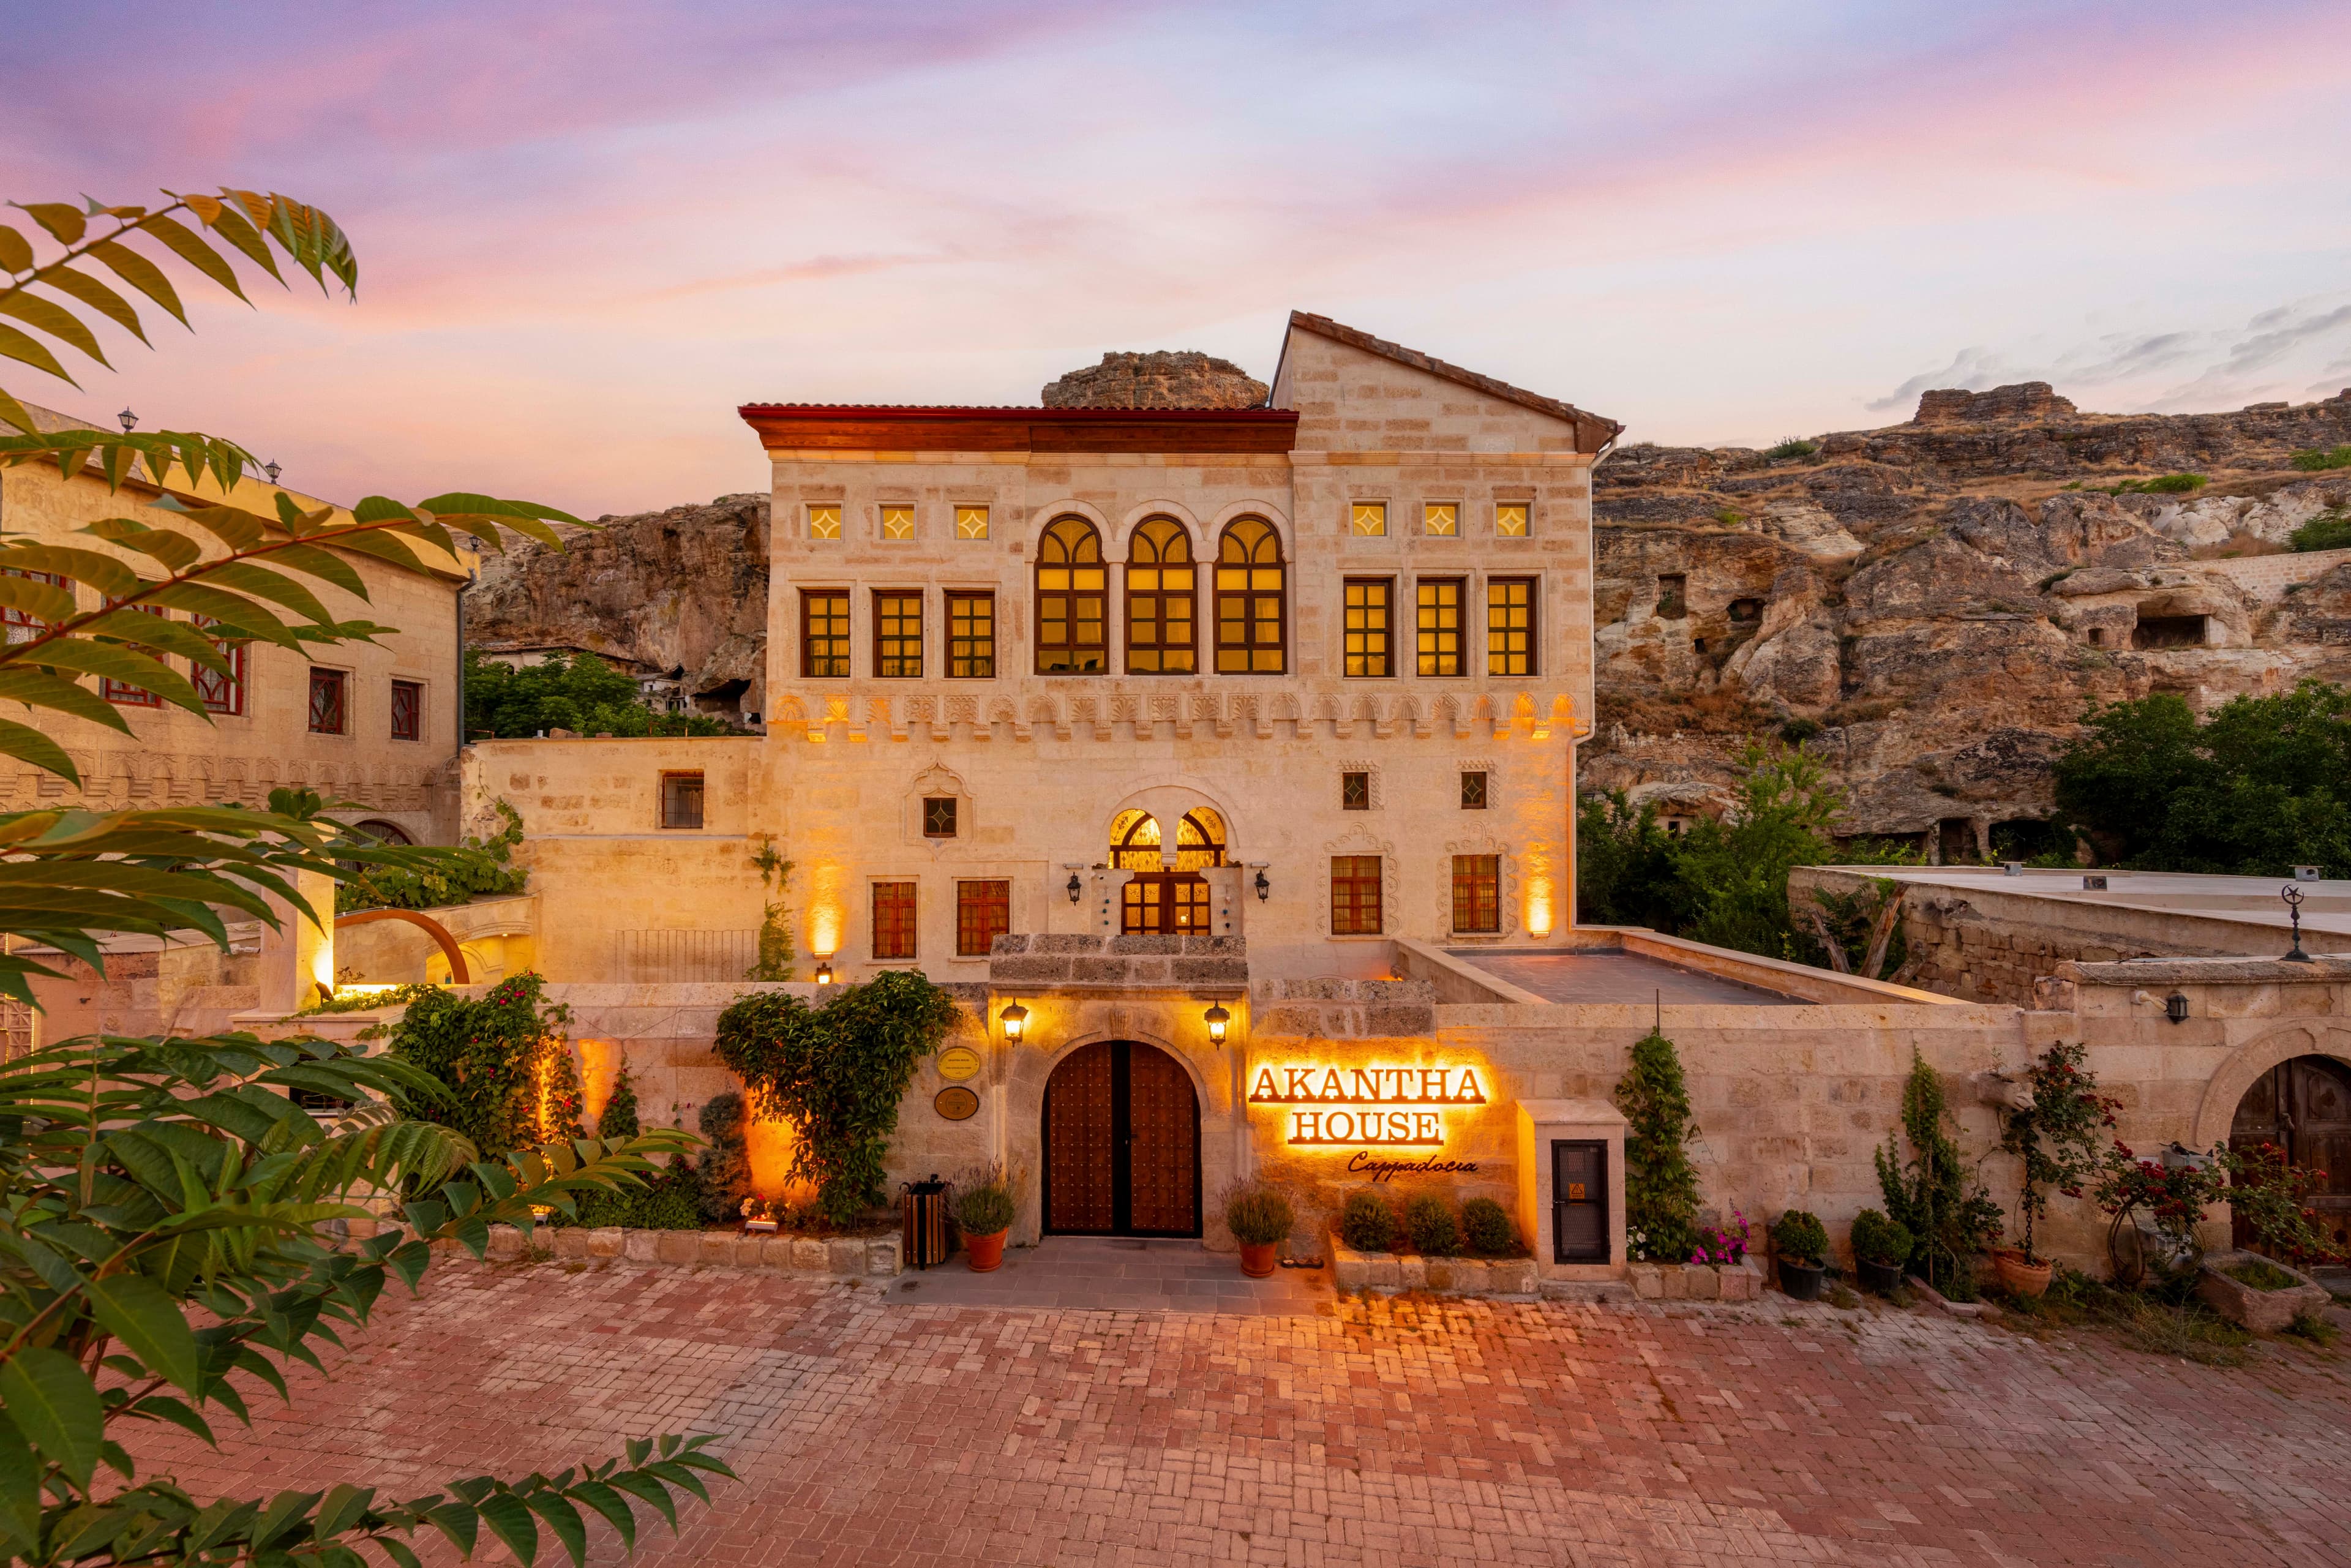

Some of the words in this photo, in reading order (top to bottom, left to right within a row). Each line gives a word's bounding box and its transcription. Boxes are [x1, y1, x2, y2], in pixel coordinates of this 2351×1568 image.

[1250, 1068, 1485, 1101] AKANTHA
[1292, 1112, 1439, 1141] HOUSE
[1348, 1150, 1477, 1182] Cappadocia
